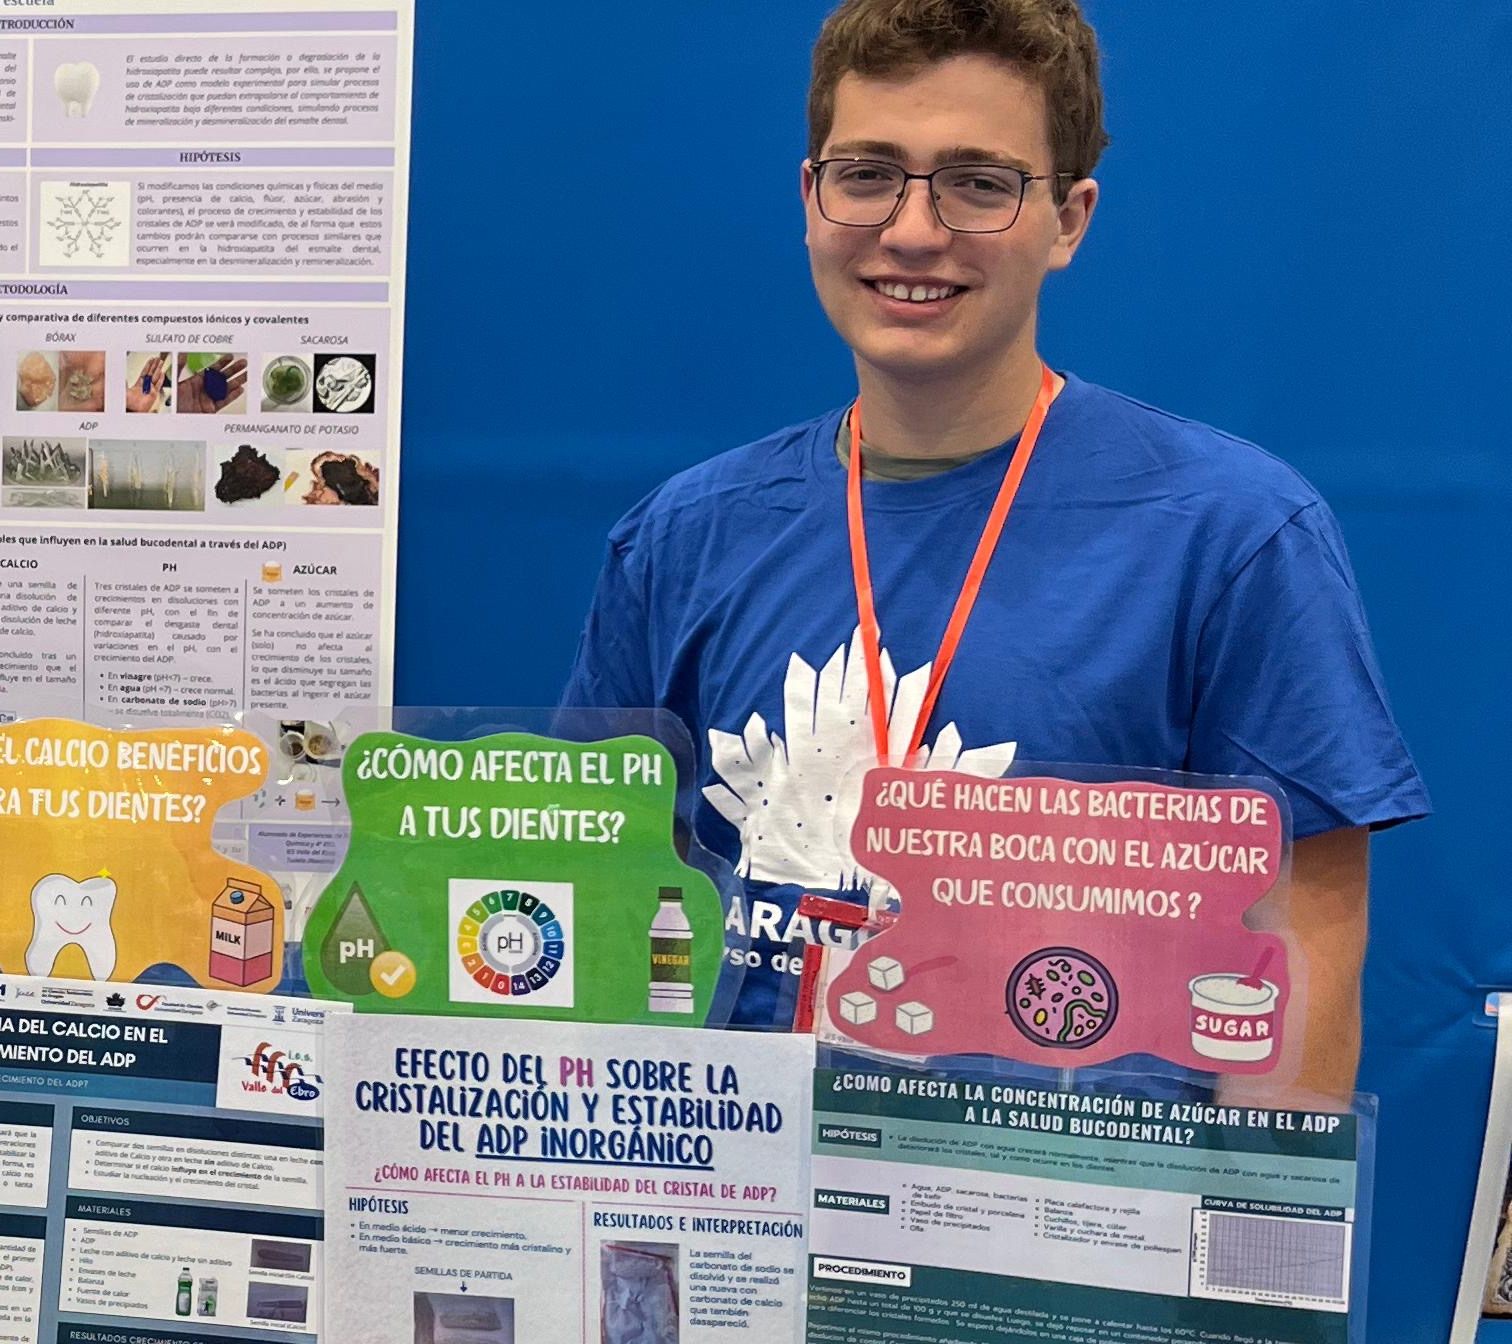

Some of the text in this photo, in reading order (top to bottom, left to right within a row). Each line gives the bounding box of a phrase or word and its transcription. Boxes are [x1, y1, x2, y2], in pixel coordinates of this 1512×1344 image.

[179, 149, 241, 162] HIPÓTESIS
[300, 335, 348, 345] SACAROSA
[0, 558, 38, 569] CALCIO
[292, 564, 337, 575] AZÚCAR
[24, 738, 109, 768] CALCIO
[116, 739, 265, 775] BENEFICIOS
[356, 743, 661, 785] ¿CÓMO AFECTA EL PH
[28, 788, 79, 818] TUS
[87, 790, 206, 823] DIENTES?
[876, 778, 1267, 825] ¿QUÉ HACEN LAS BACTERIAS DE
[399, 804, 625, 843] A TUS DIENTES?
[866, 826, 1268, 874] NUESTRA BOCA CON EL AZÚCAR
[932, 877, 993, 906] QUE
[1001, 881, 1180, 918] CONSUMIMOS
[18, 1017, 48, 1034] DEL
[51, 1020, 120, 1039] CALCIO
[123, 1025, 146, 1041] EN
[148, 1027, 168, 1043] EL
[1194, 1010, 1270, 1039] SUGAR
[66, 1048, 97, 1065] DEL
[99, 1051, 136, 1067] ADP
[395, 1047, 739, 1095] EFECTO DEL PH SOBRE LA
[581, 1092, 599, 1123] Y
[896, 1078, 957, 1099] AFECTA
[964, 1084, 984, 1101] LA
[991, 1086, 1135, 1116] CONCENTRACIÓN
[1141, 1100, 1163, 1119] DE
[1169, 1102, 1240, 1126] AZÚCAR
[1247, 1109, 1268, 1128] EN
[1275, 1111, 1295, 1130] EL
[1301, 1114, 1340, 1133] ADP
[417, 1117, 465, 1153] DEL
[476, 1123, 529, 1156] ADP
[821, 1127, 877, 1142] HIPÓTESIS
[964, 1105, 1194, 1145] A LA SALUD BUCODENTAL?
[817, 1193, 885, 1209] MATERIALES
[69, 1330, 127, 1343] RESULTADOS
